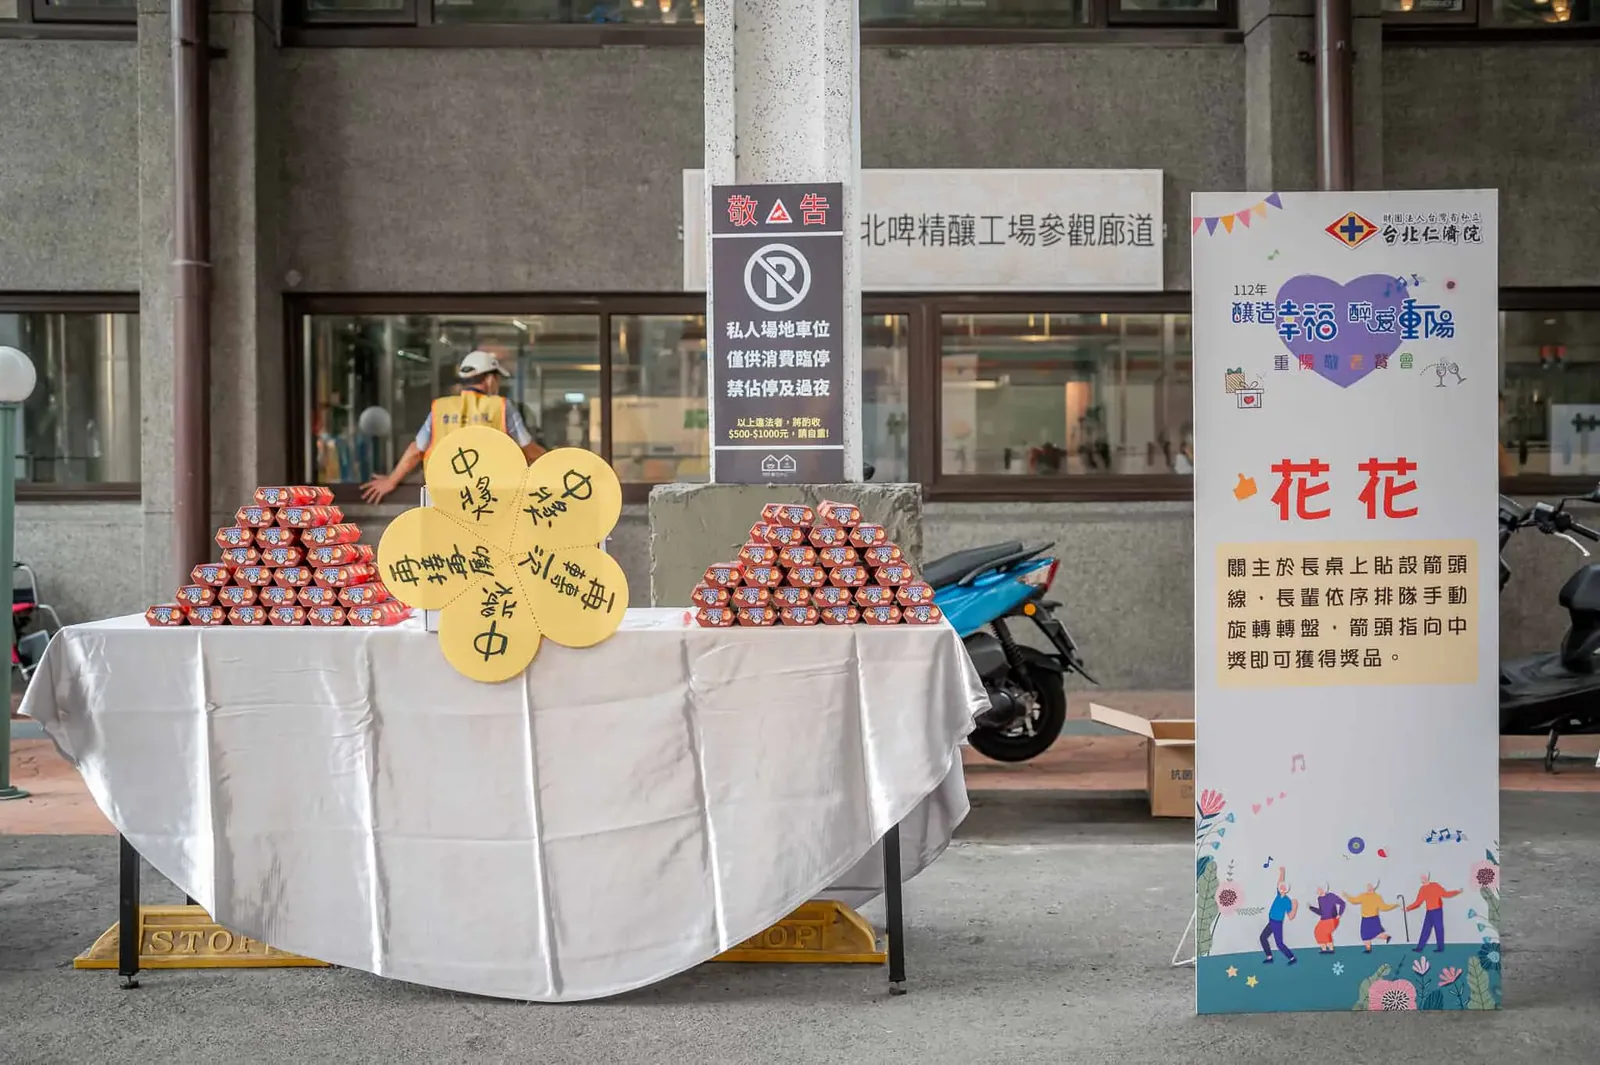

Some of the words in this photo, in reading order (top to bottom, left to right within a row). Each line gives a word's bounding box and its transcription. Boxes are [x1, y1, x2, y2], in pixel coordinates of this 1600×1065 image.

[859, 212, 1155, 247] 北啤精釀工場參觀廊道
[1382, 224, 1482, 244] 台北仁濟院
[1233, 283, 1268, 297] 112年
[726, 320, 831, 339] 私人場地車位
[1231, 299, 1339, 342] 釀造幸福
[726, 349, 831, 369] 僅供消費臨停
[726, 378, 831, 398] 禁佔停及過夜
[1226, 554, 1469, 578] 關主於長桌上貼設箭頭
[1226, 648, 1400, 670] 獎即可獲得獎品。
